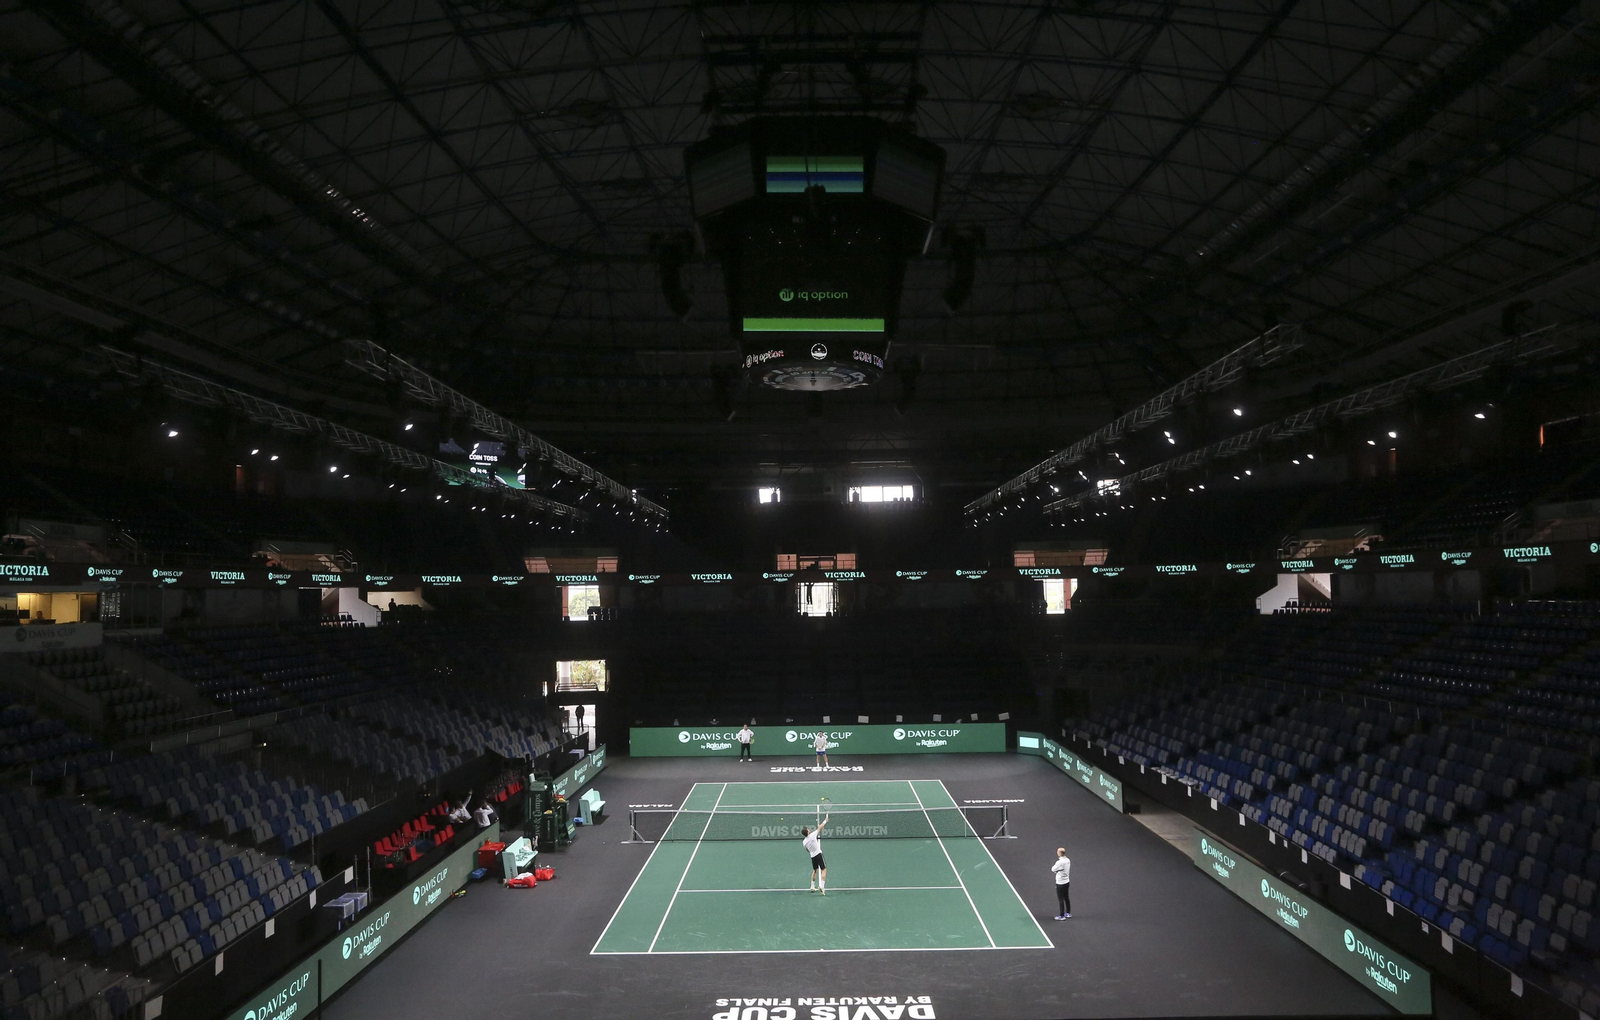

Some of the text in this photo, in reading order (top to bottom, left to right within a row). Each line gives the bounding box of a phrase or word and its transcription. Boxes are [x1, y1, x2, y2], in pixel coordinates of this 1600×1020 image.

[798, 290, 848, 301] iq option
[1504, 547, 1551, 558] VICTORIA
[1282, 560, 1314, 569] VICTORIA
[1380, 555, 1414, 564] VICTORIA
[0, 565, 49, 576] ICTORIA
[211, 572, 245, 580] VICTORIA
[29, 628, 75, 639] DAVIS CUP
[693, 733, 721, 741] DAVIS
[800, 732, 828, 740] DAVS
[938, 729, 960, 737] CUP
[706, 742, 731, 750] Rakuten
[921, 739, 947, 747] Rakuten
[751, 826, 789, 837] DAVIS
[821, 826, 833, 838] by
[836, 826, 887, 836] RAKUTEN
[1208, 844, 1236, 869] DAVIS CUP
[1216, 863, 1229, 878] Rakuten
[421, 867, 448, 896] DAVIS CUP
[428, 887, 442, 904] Rakuten
[1271, 887, 1308, 918] DAVIS CUP
[1280, 908, 1299, 928] Rakuten
[353, 911, 390, 948] DAVIS CUP
[363, 935, 382, 956] Rakuten
[1357, 940, 1411, 983] DAVIS CUP
[1370, 966, 1397, 994] Rakuten
[258, 971, 309, 1020] DAVIS CUP
[716, 995, 932, 1007] BY RAKUTEN FINALS
[712, 1005, 936, 1020] DAVIS CUP
